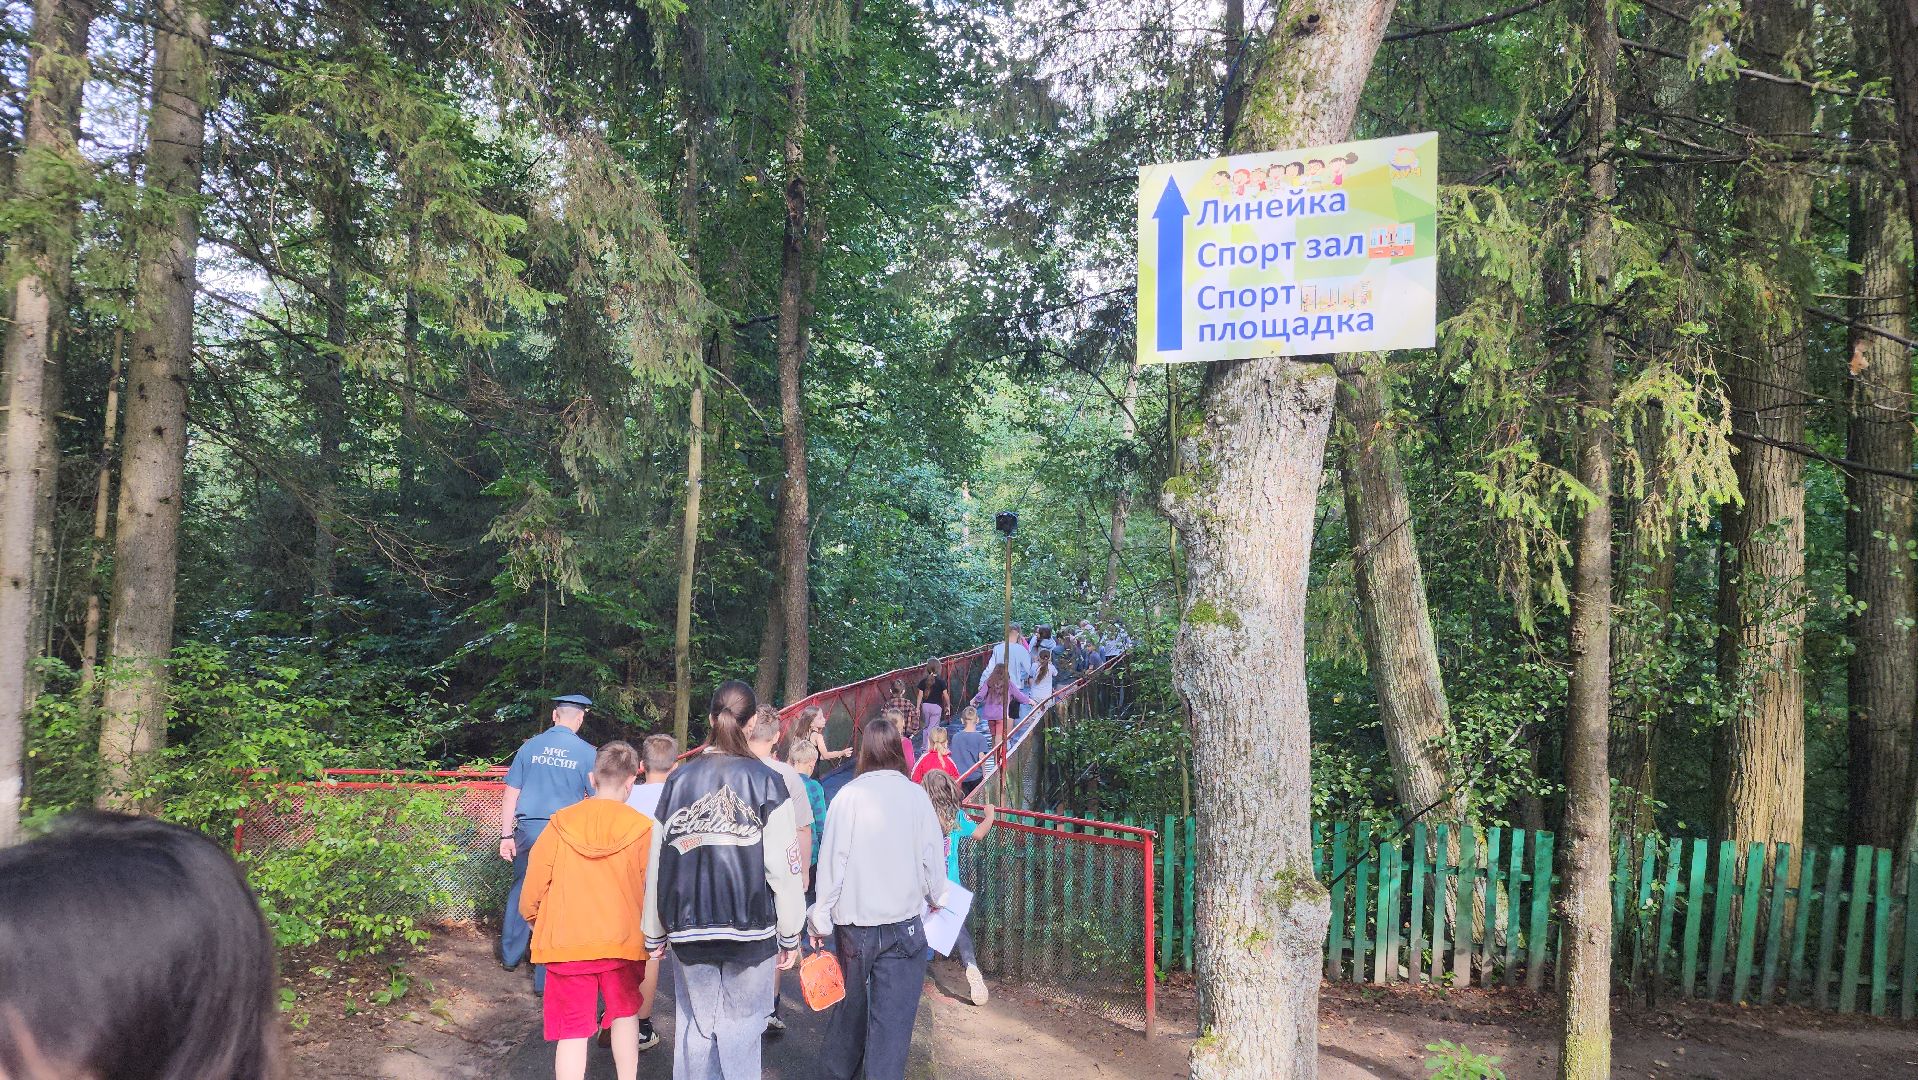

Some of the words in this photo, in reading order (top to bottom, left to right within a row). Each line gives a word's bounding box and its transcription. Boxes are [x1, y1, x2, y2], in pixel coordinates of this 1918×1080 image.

[1197, 189, 1346, 226] Линейка
[1198, 241, 1296, 269] Спорт
[1306, 235, 1363, 259] зал
[1198, 285, 1295, 312] Спорт
[1199, 312, 1374, 342] площадка
[531, 755, 577, 770] РОССИИ
[542, 747, 569, 758] МЧС
